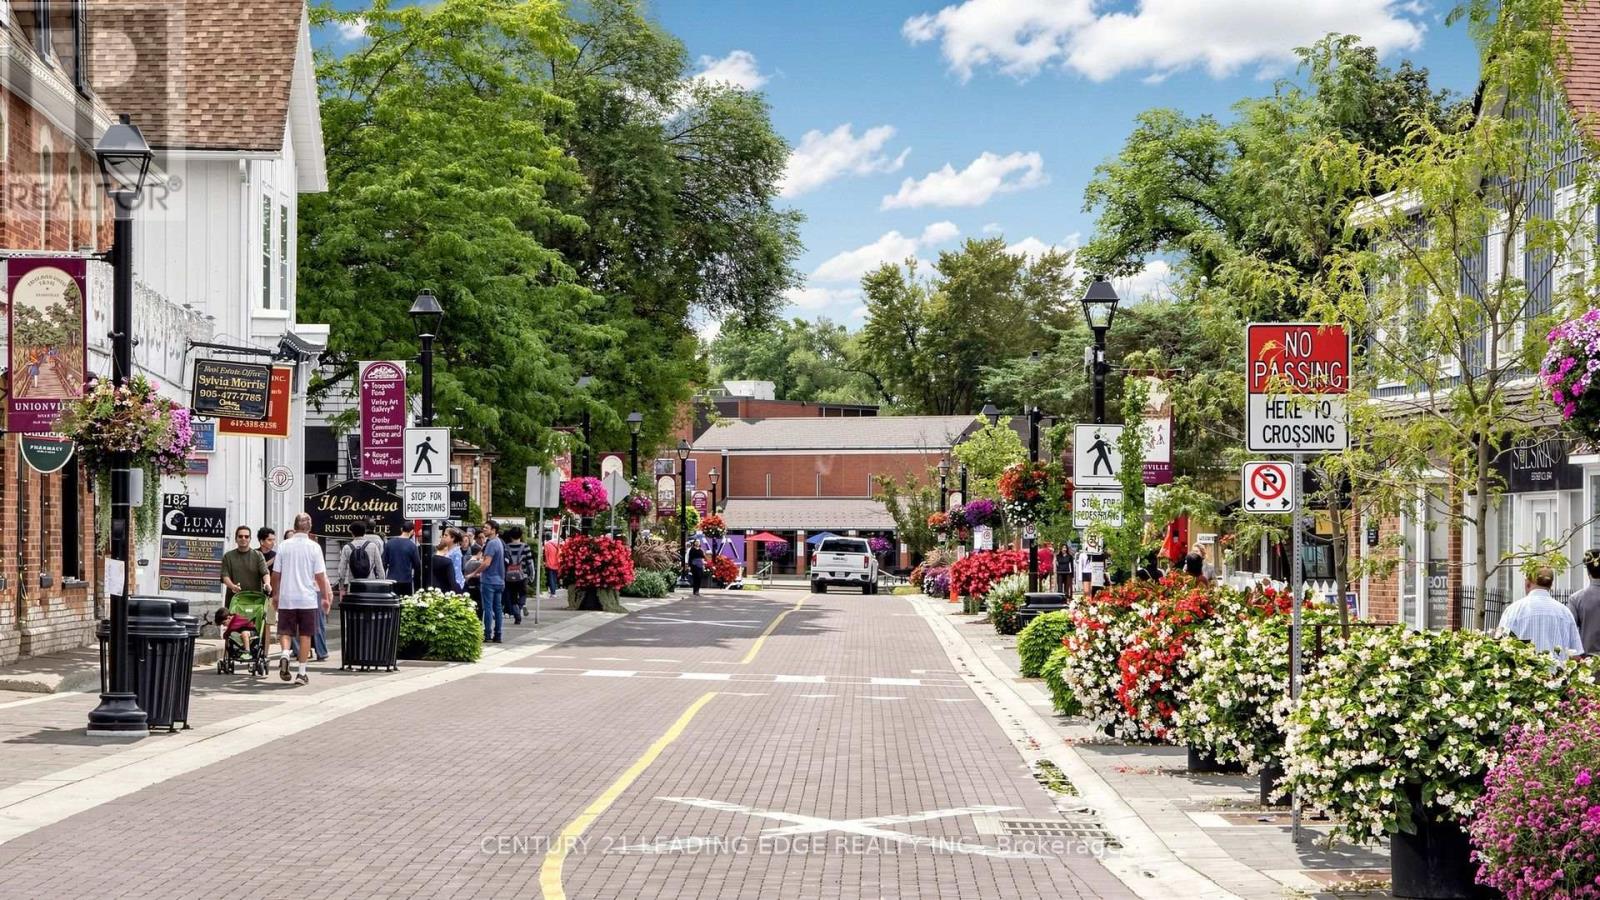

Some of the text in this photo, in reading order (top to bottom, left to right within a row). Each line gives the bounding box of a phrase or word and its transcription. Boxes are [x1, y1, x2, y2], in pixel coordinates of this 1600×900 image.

[1284, 331, 1312, 358] NO
[1254, 361, 1342, 388] PASSING
[198, 375, 229, 387] Sylvia
[231, 378, 266, 389] Morris
[371, 405, 391, 413] Gallery
[1265, 400, 1331, 419] HERE TO
[371, 424, 402, 432] Community
[1263, 425, 1336, 443] CROSSING
[372, 451, 389, 459] Rouge
[166, 494, 187, 506] 182
[411, 491, 442, 501] STOP FOR
[338, 495, 398, 512] Postino
[407, 503, 446, 512] PEDESTRIANS
[184, 517, 224, 529] LUNA
